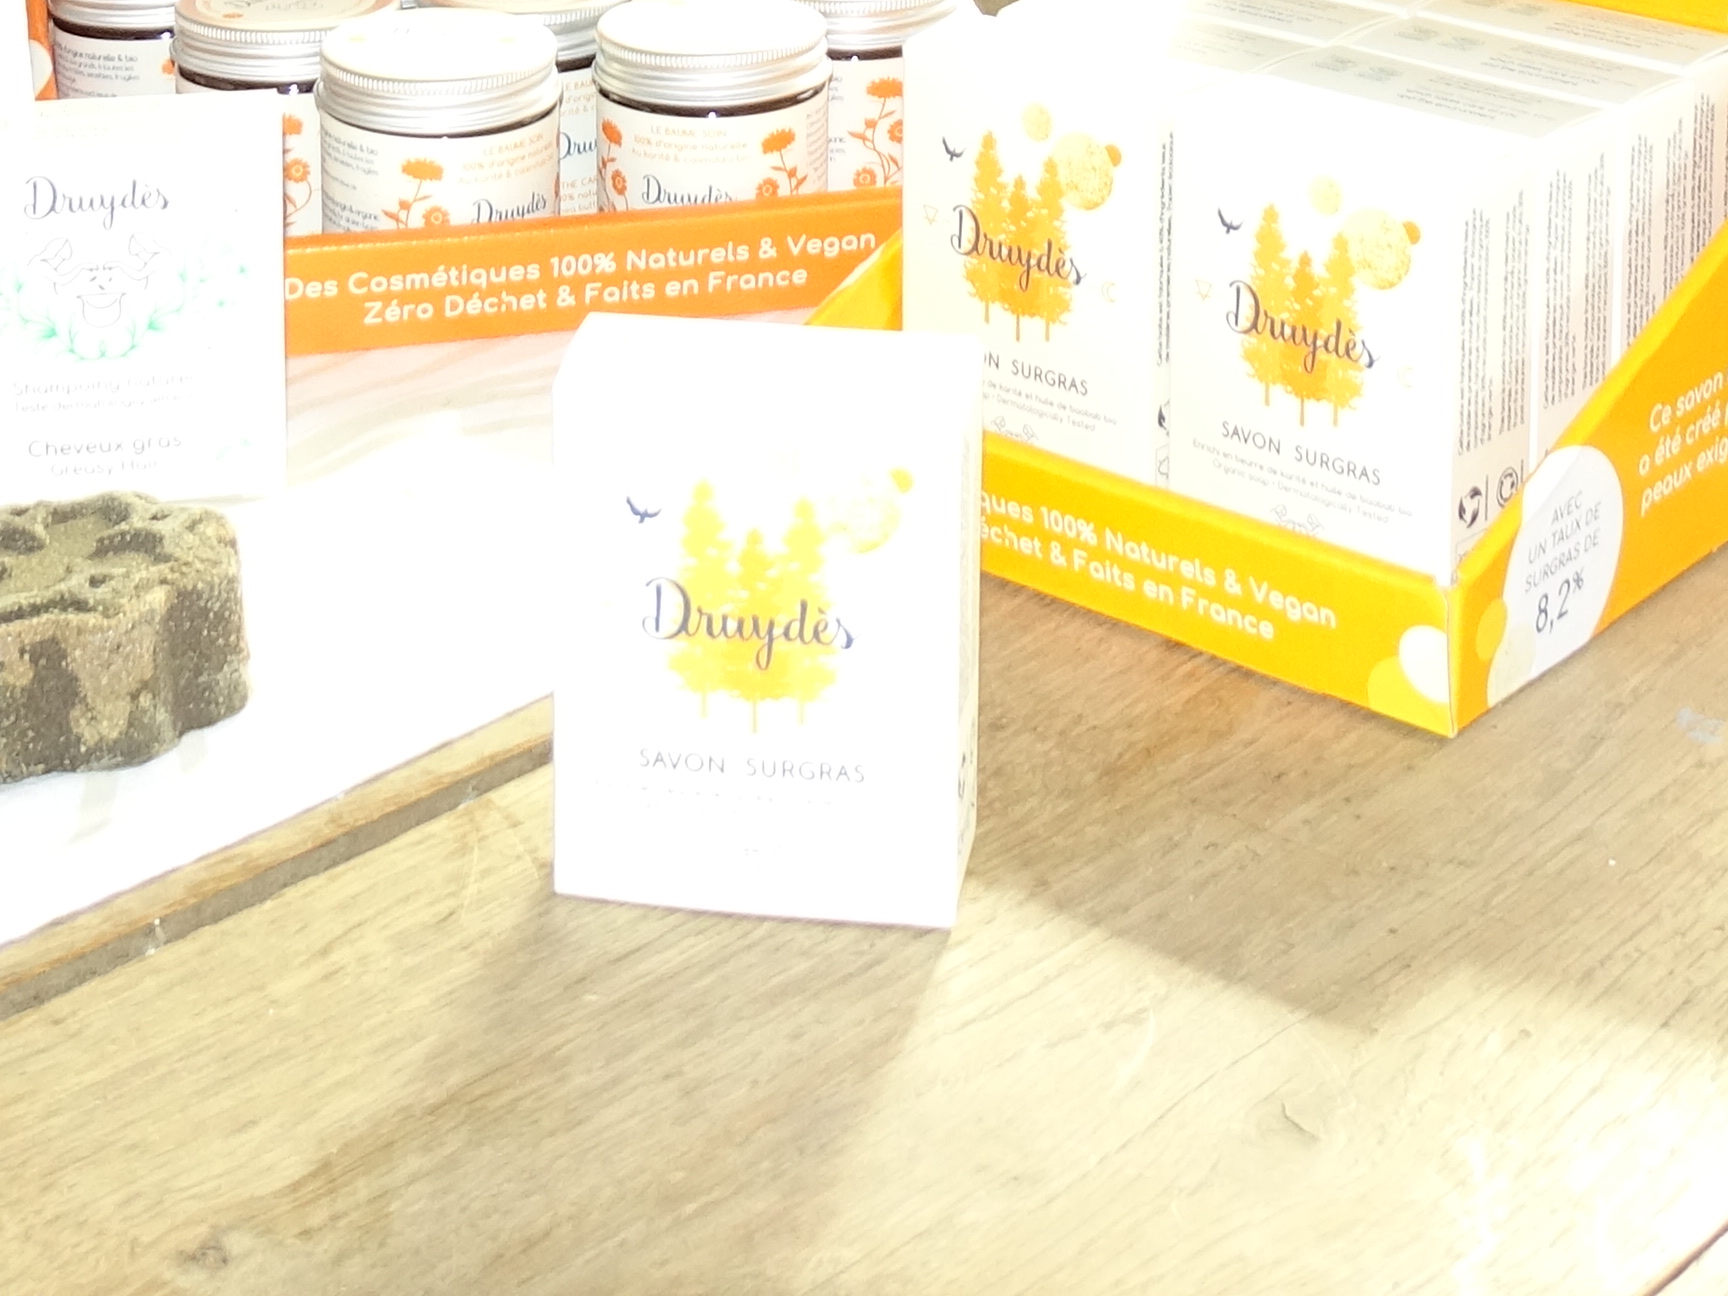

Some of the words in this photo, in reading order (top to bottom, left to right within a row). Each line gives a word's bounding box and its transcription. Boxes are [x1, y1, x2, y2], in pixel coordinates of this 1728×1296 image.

[23, 175, 171, 230] Druydès
[284, 277, 338, 301] Des
[347, 262, 541, 295] Cosmétiques
[550, 252, 617, 278] 100%
[626, 241, 750, 271] Naturels
[758, 237, 777, 258] &
[786, 232, 876, 258] Vegan
[950, 205, 1087, 292] Druydès
[364, 299, 433, 325] Zéro
[445, 289, 547, 317] Déchet
[557, 285, 575, 307] &
[585, 280, 655, 304] Faits
[665, 277, 699, 296] en
[708, 268, 808, 293] France
[1226, 280, 1381, 373] Druydès
[1011, 358, 1088, 396] SURGRAS
[1649, 403, 1672, 433] Ce
[1676, 371, 1723, 418] savon
[28, 440, 124, 457] Cheveux
[132, 436, 182, 455] gras
[1221, 420, 1281, 456] SAVON
[1294, 444, 1381, 486] SURGRAS
[1639, 454, 1650, 476] a
[1654, 425, 1682, 466] été
[1685, 400, 1722, 446] créé
[1551, 490, 1583, 526] AVEC
[1641, 461, 1693, 517] peaux
[1525, 541, 1580, 593] SURGRAS
[1584, 528, 1600, 553] DE
[1528, 539, 1547, 564] UN
[1552, 516, 1581, 548] TAUX
[1585, 501, 1602, 526] DE
[1041, 506, 1097, 546] 100%
[1105, 527, 1216, 588] Naturels
[1224, 568, 1242, 597] &
[1248, 576, 1336, 629] Vegan
[1050, 541, 1067, 567] &
[1073, 549, 1136, 592] Faits
[1143, 577, 1174, 605] en
[1180, 585, 1274, 640] France
[1536, 566, 1584, 634] 8,2%
[642, 576, 859, 671] Druydès
[639, 748, 726, 775] SAVON
[746, 757, 867, 784] SURGRAS
